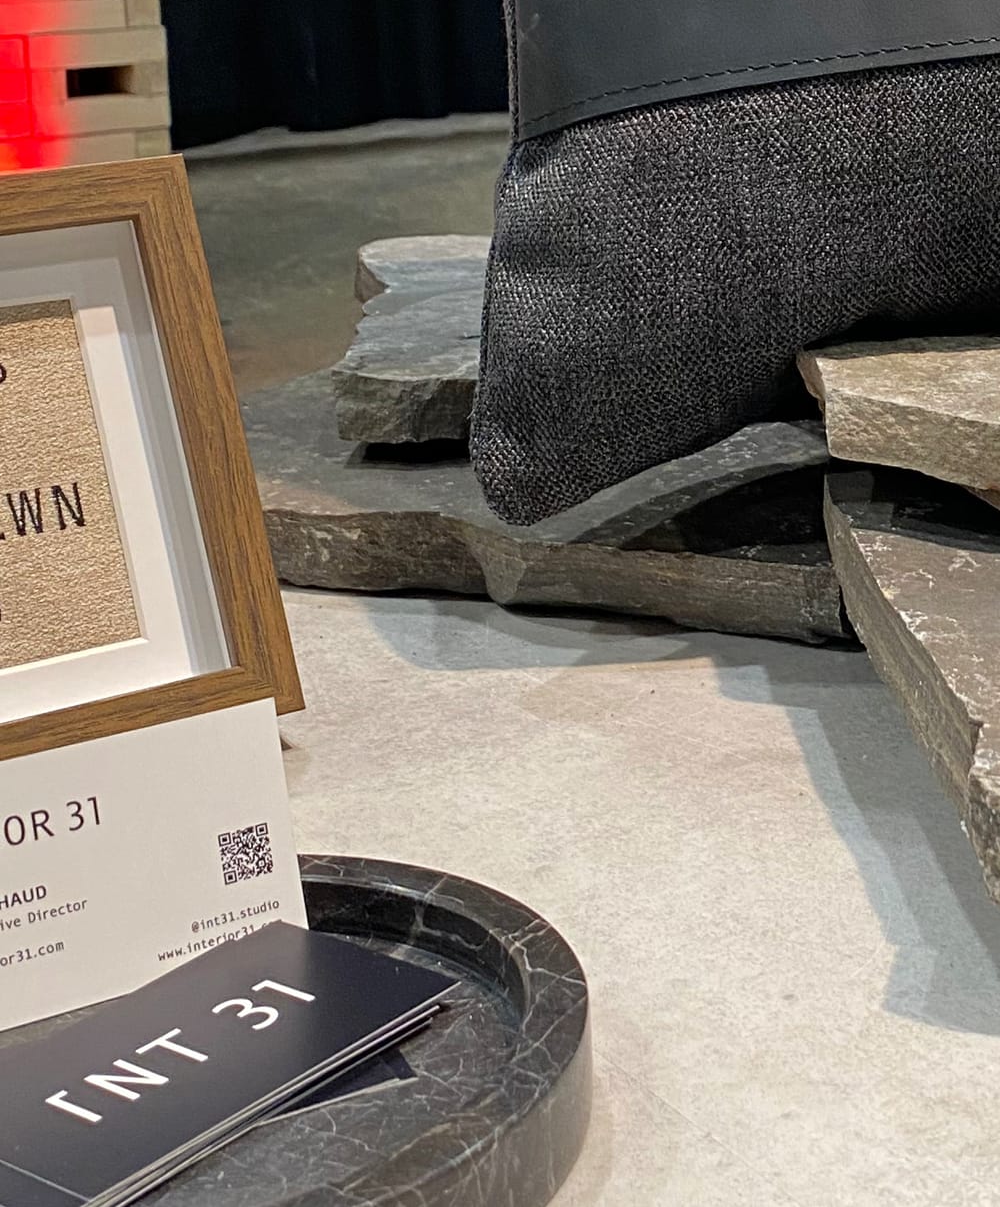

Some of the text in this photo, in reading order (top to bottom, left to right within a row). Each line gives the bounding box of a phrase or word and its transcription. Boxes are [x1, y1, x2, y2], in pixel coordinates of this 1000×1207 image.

[0, 482, 86, 542] WN
[66, 796, 100, 831] 31
[28, 899, 88, 924] Director
[191, 900, 279, 933] @int31.studio
[45, 979, 316, 1122] INT 31
